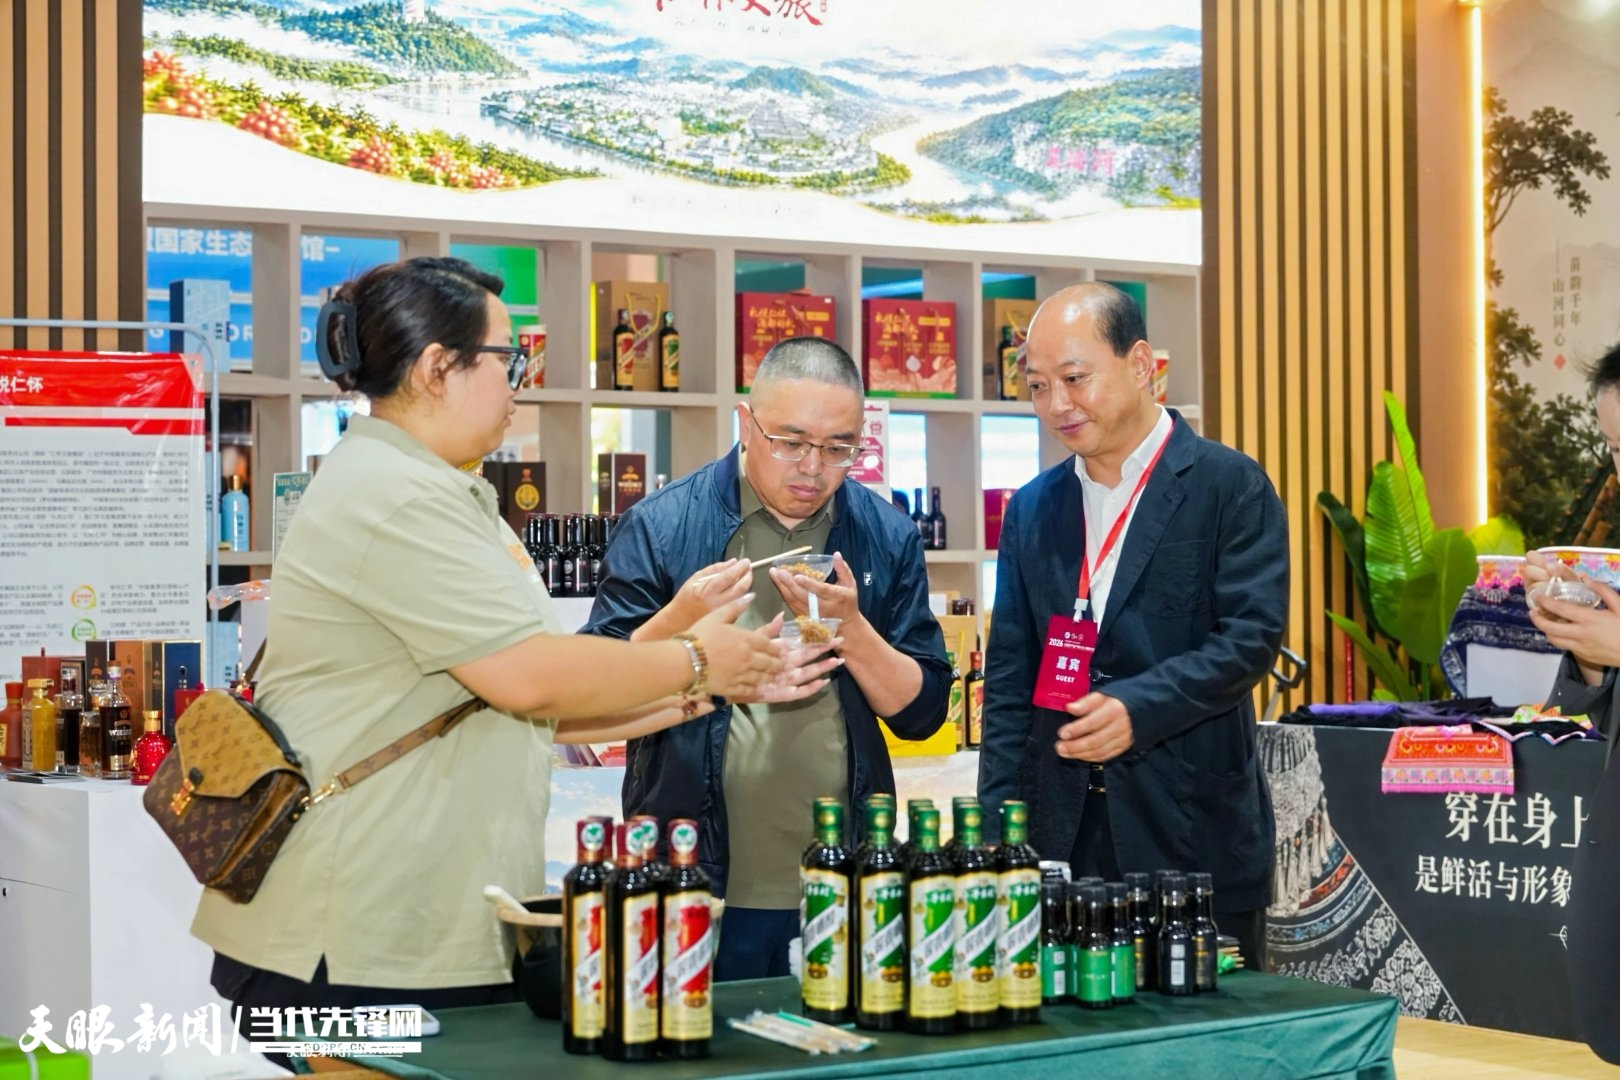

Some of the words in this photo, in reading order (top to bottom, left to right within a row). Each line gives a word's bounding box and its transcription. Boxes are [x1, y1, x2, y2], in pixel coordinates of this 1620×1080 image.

[1049, 638, 1064, 648] 2026
[1056, 655, 1080, 672] 嘉宾
[1055, 674, 1075, 683] GUEST
[1415, 855, 1572, 907] 是鲜活与形象
